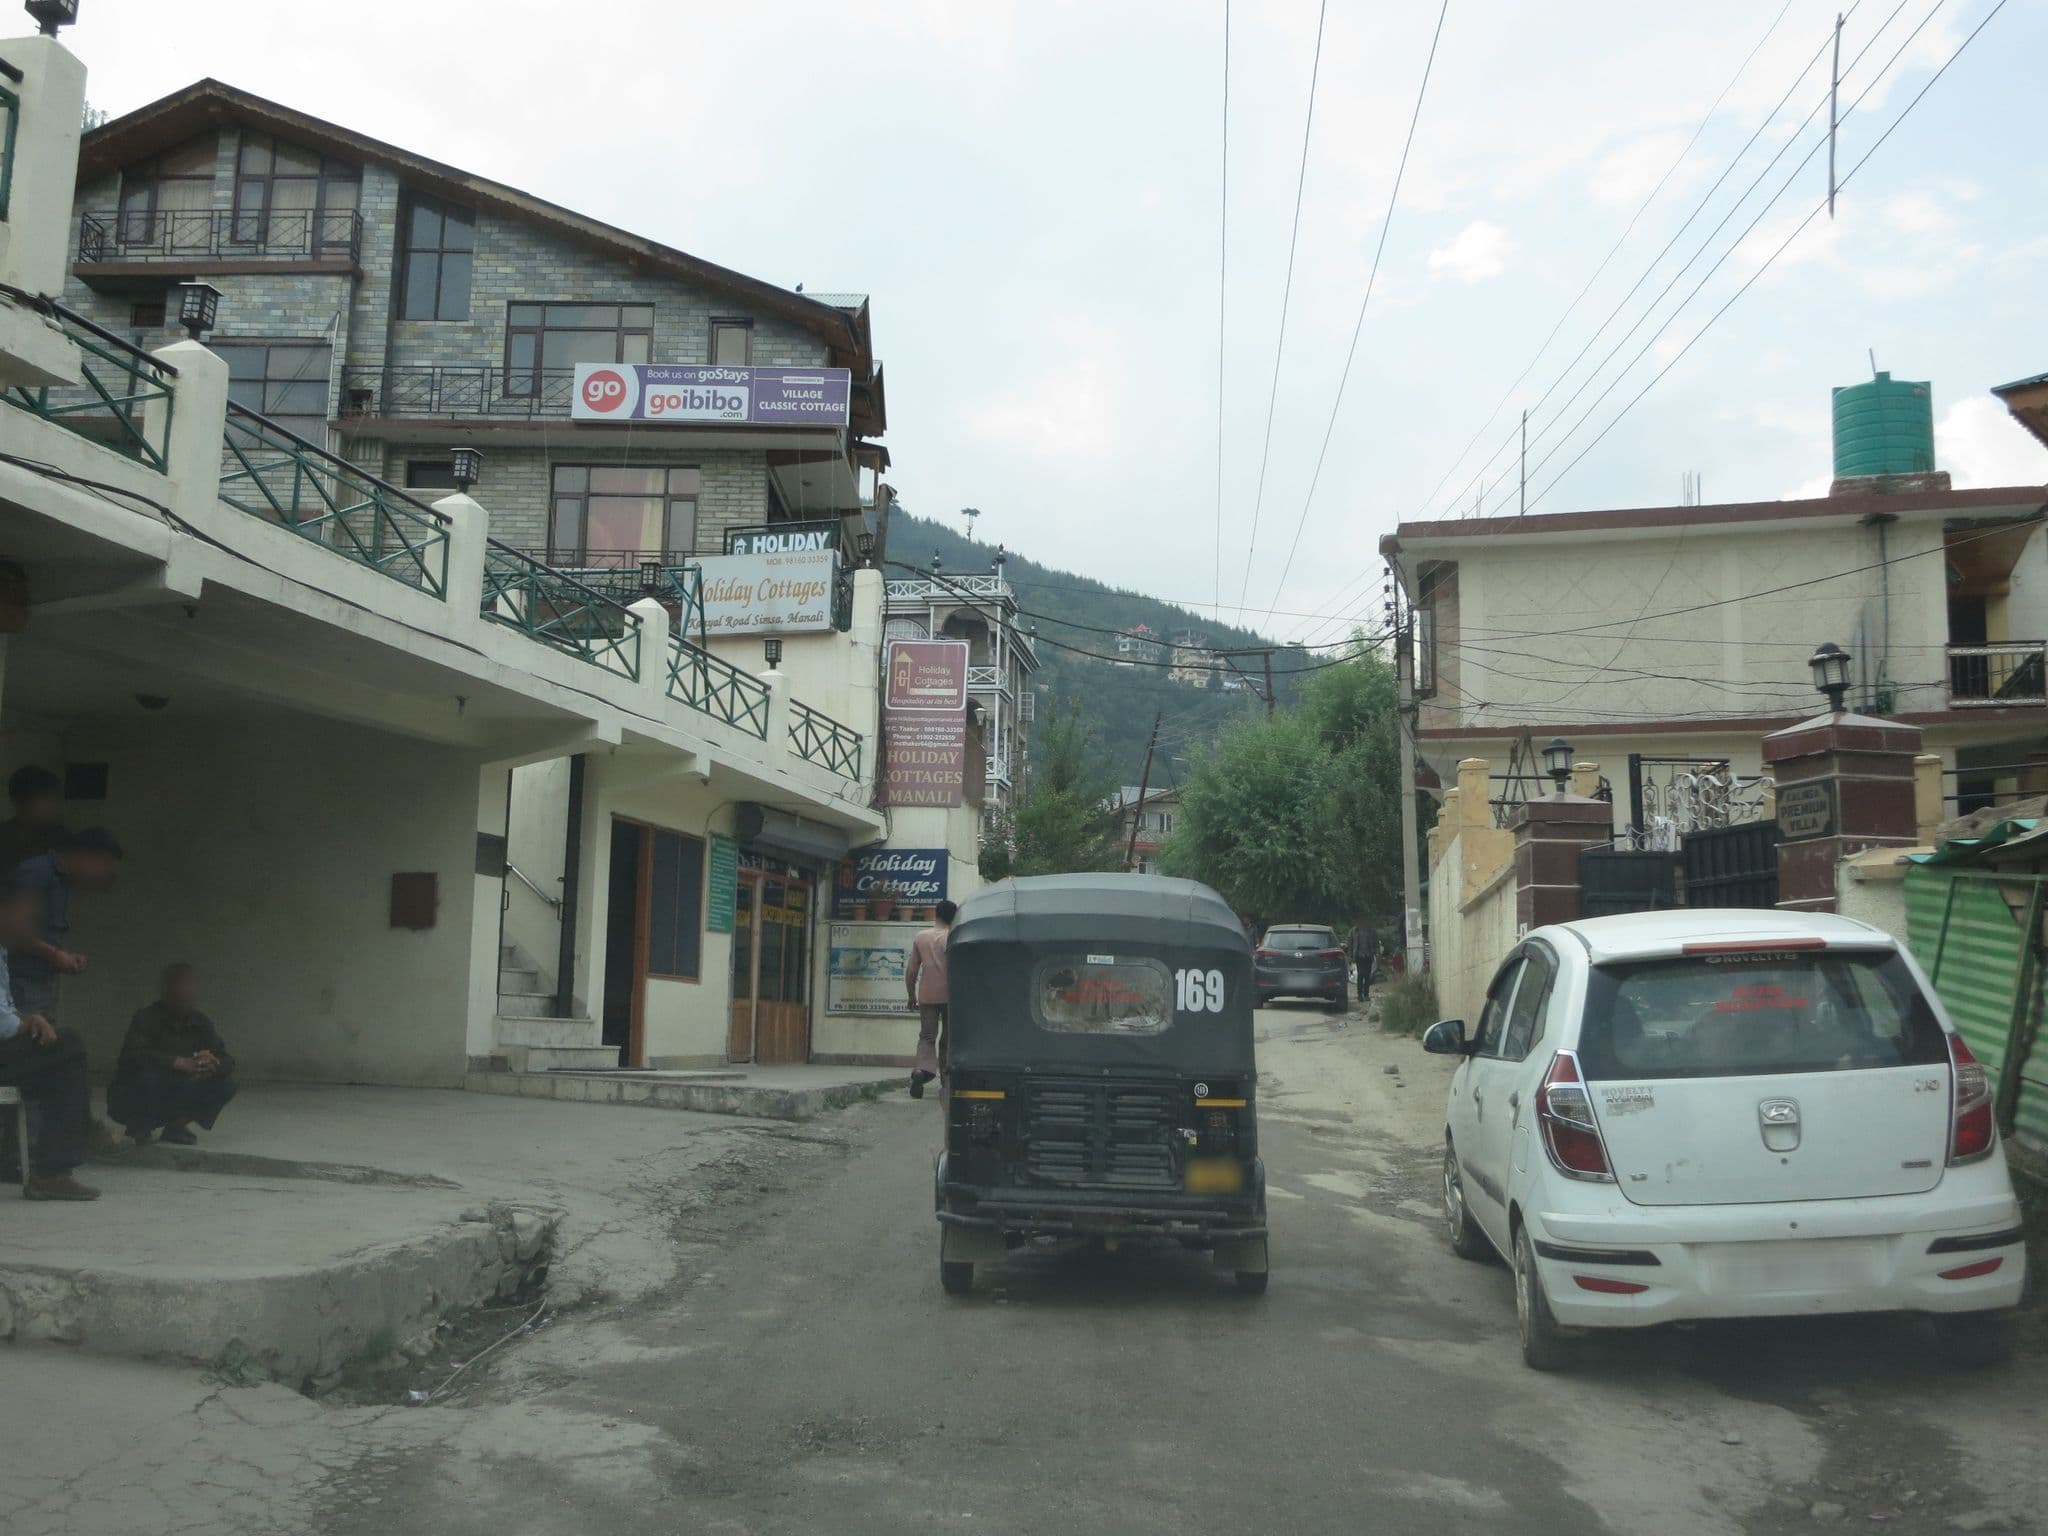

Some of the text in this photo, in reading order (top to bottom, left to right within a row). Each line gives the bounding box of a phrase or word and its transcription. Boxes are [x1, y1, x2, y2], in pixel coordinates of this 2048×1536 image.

[647, 369, 670, 378] Book
[698, 368, 750, 383] goStays
[588, 381, 620, 402] go
[782, 390, 824, 399] VILLAGE
[650, 389, 743, 415] goibibo
[759, 401, 846, 412] CLASSIC COTTAGE
[720, 410, 742, 418] .com
[752, 532, 830, 554] HOLIDAY
[758, 577, 827, 605] Cottages
[725, 613, 750, 628] Road
[787, 611, 824, 624] Manali
[918, 665, 952, 676] Holiday
[914, 676, 954, 687] Cottages
[887, 750, 960, 765] HOLIDAY
[887, 769, 963, 784] OTTAGES
[888, 790, 952, 804] MANALI
[857, 854, 937, 876] Holiday
[856, 876, 941, 897] Cottages
[1174, 968, 1225, 1014] 169
